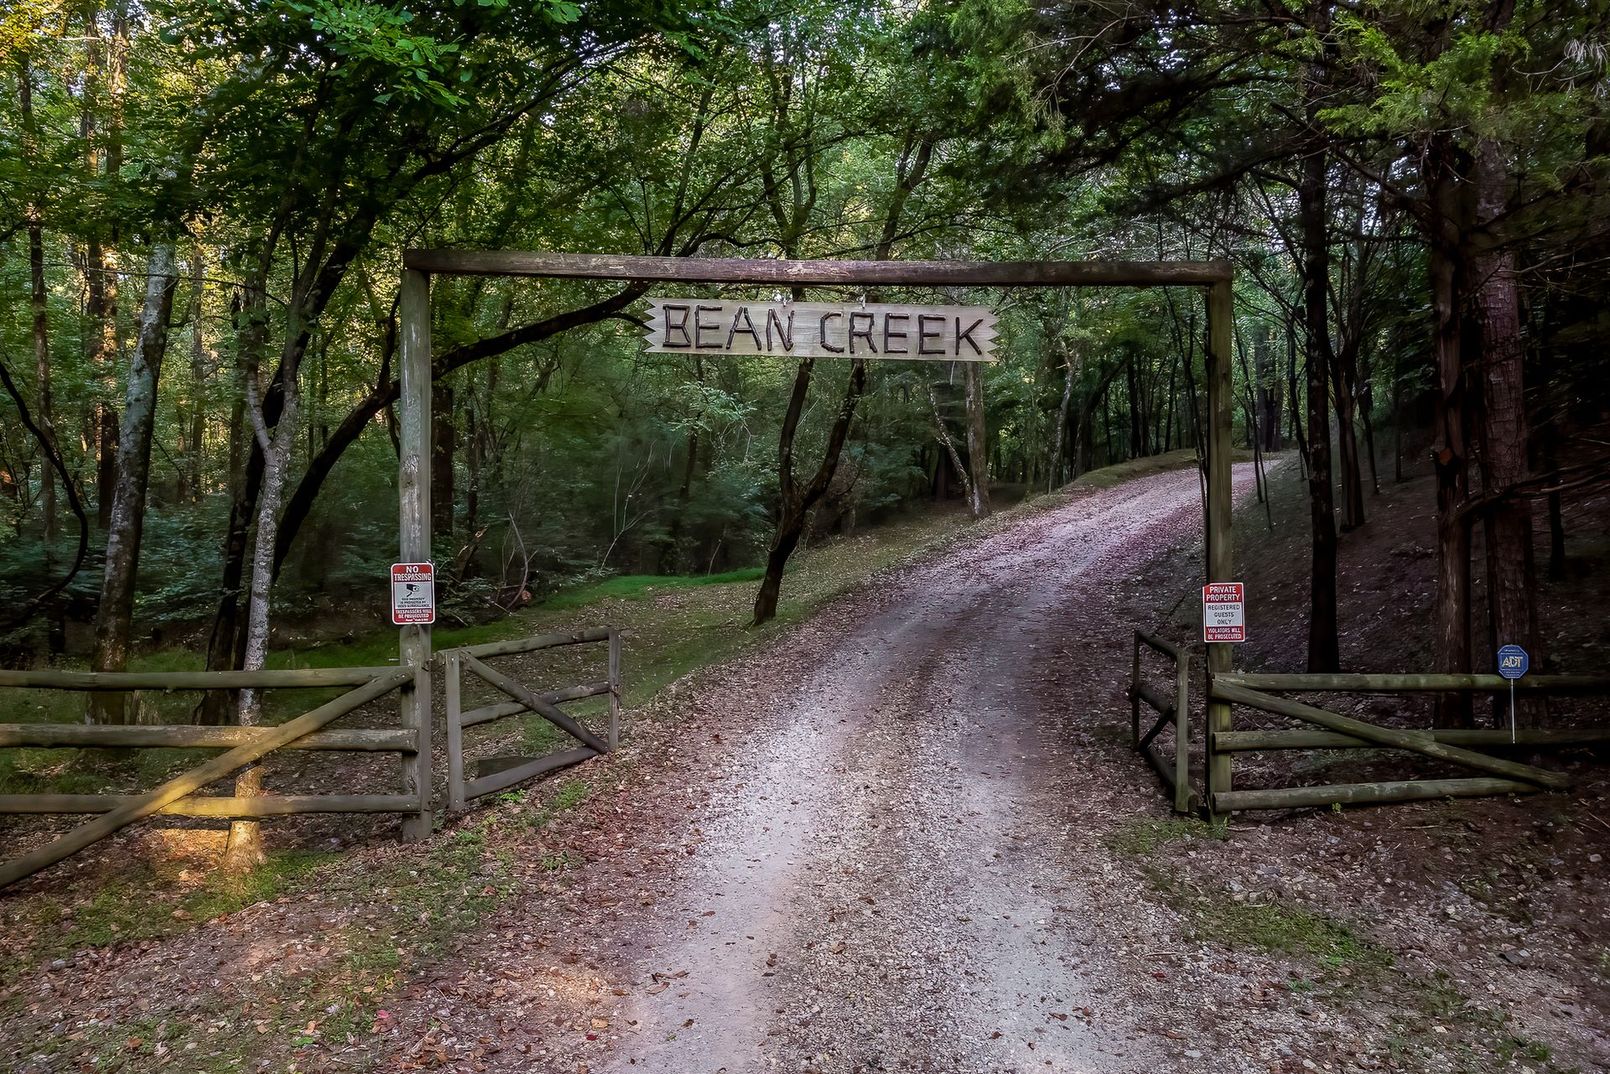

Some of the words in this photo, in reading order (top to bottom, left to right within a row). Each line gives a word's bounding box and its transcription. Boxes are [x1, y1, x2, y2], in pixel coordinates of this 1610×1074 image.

[662, 303, 796, 352] BEAN
[819, 310, 985, 356] CREEK
[394, 573, 432, 581] TRESPASSING
[1501, 656, 1523, 668] ADT
